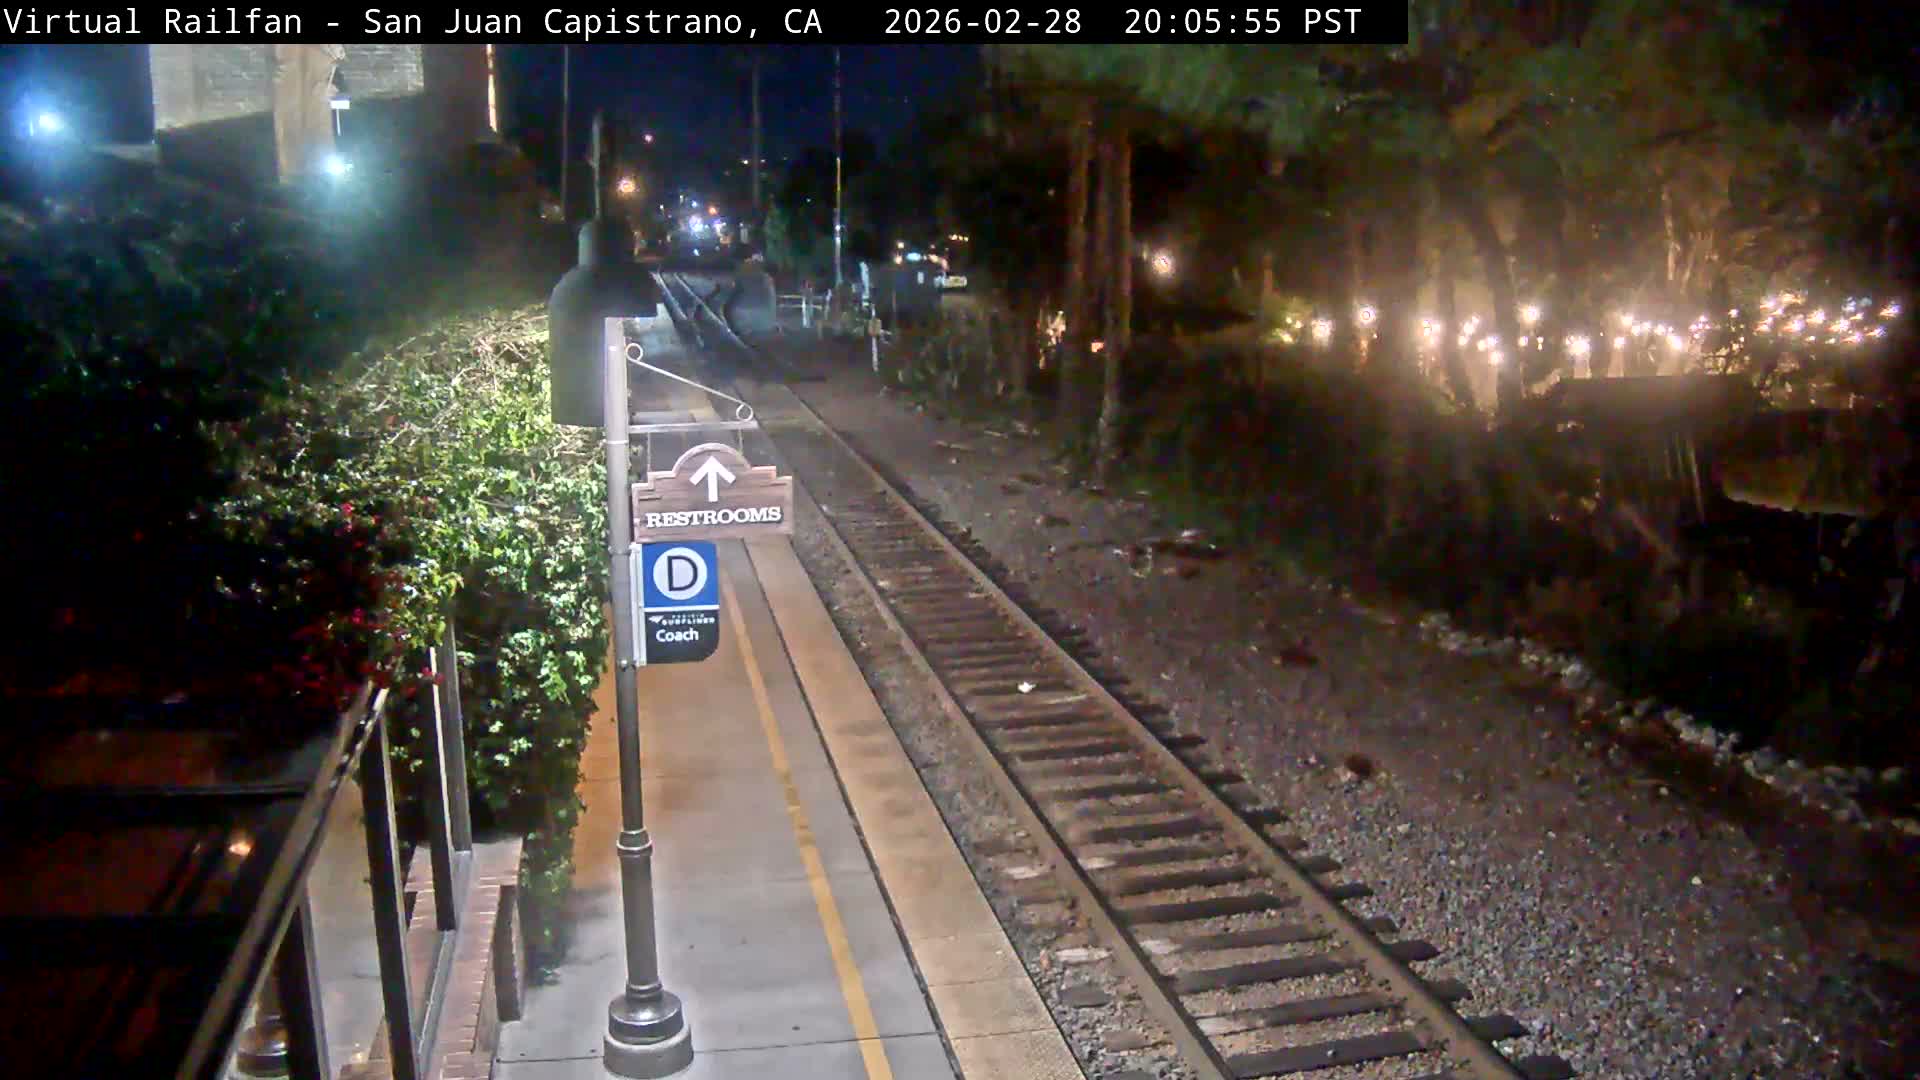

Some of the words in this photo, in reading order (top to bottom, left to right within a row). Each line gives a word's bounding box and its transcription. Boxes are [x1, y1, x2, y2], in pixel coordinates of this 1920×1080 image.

[645, 506, 782, 528] RESTROOMS
[667, 555, 699, 592] D
[655, 627, 699, 642] Coach
